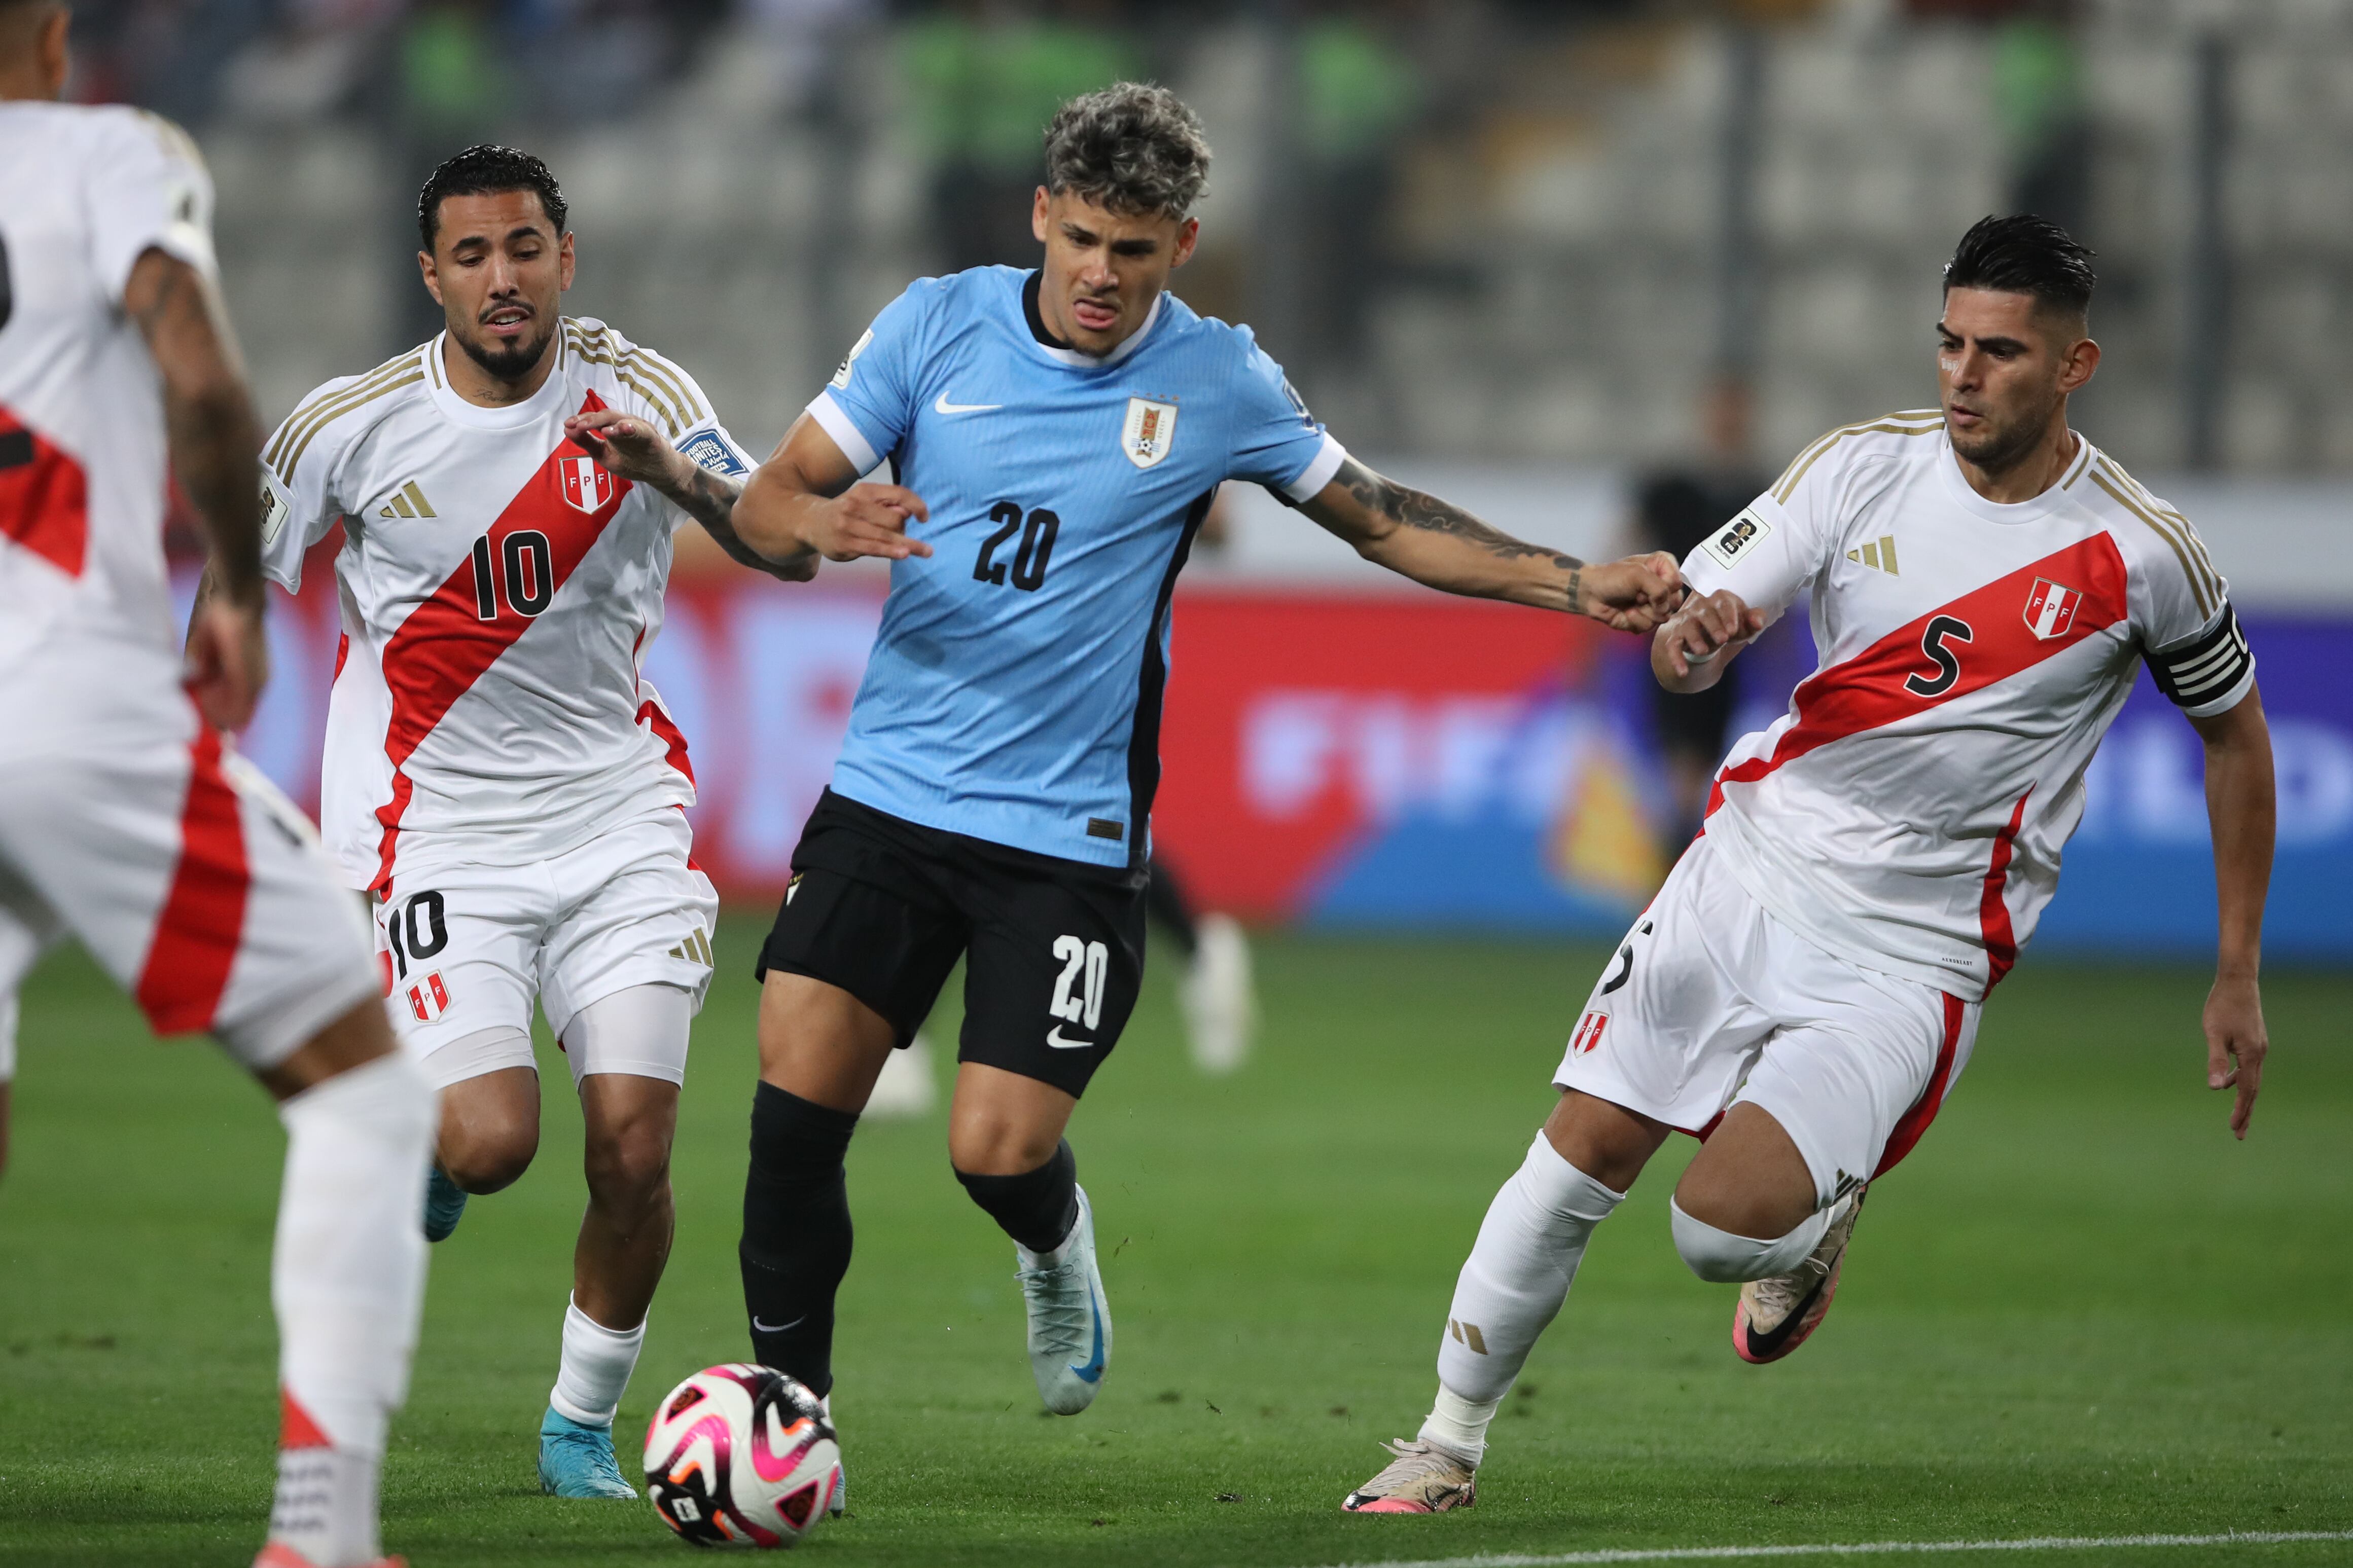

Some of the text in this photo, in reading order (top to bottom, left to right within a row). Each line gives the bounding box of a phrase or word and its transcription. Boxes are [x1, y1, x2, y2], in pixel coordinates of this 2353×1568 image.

[686, 439, 716, 456] FOOTBALL
[690, 445, 722, 463] UNITES
[707, 451, 730, 466] World
[569, 473, 604, 488] FPF
[973, 500, 1059, 592] 20
[472, 529, 554, 621] 10
[2033, 597, 2070, 617] FPF
[1903, 614, 1974, 698] 5
[389, 891, 448, 981] 10
[1600, 920, 1653, 996] 5
[415, 986, 441, 1008] FPF
[1049, 934, 1109, 1031] 20
